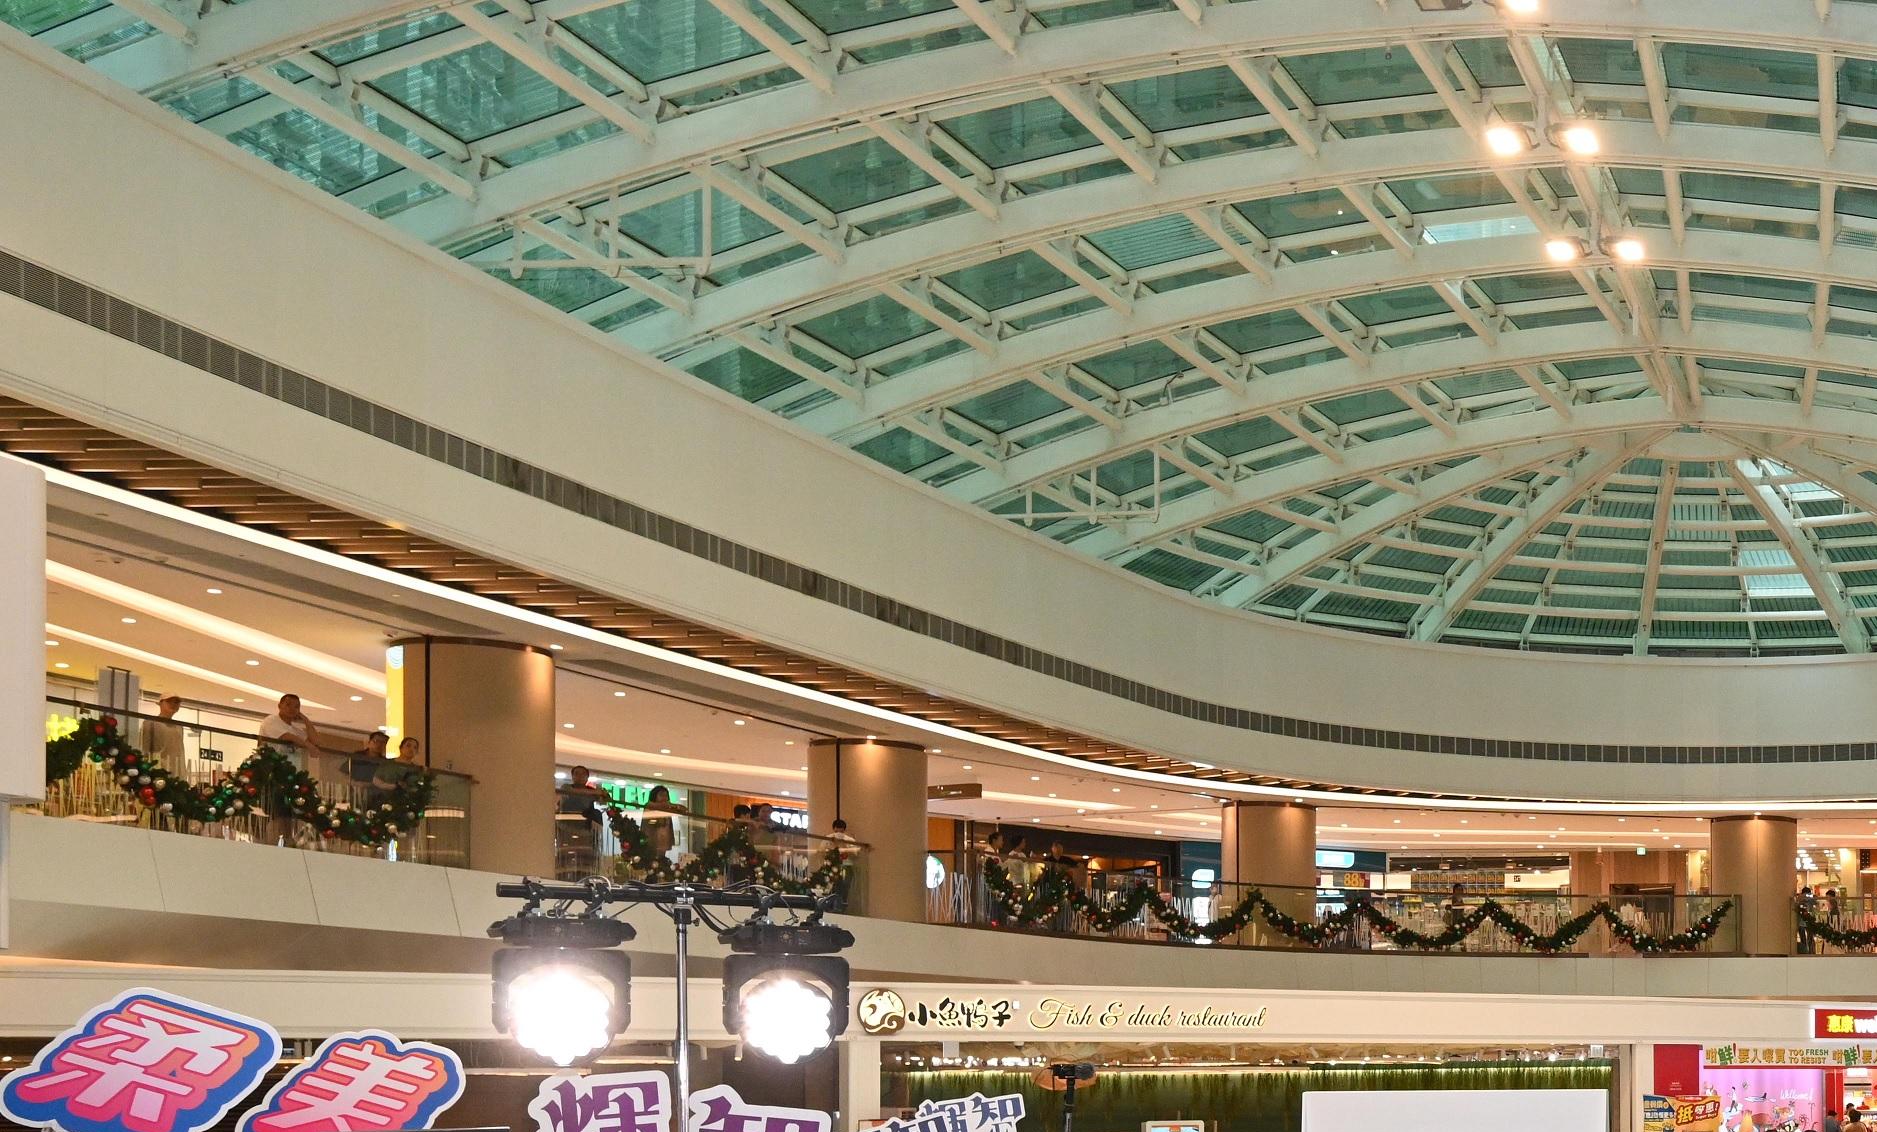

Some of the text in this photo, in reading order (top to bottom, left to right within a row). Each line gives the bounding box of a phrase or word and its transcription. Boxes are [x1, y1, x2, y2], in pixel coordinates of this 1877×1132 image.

[1029, 998, 1267, 1030] Fish & duck restaurant
[1805, 1048, 1829, 1056] FRESH
